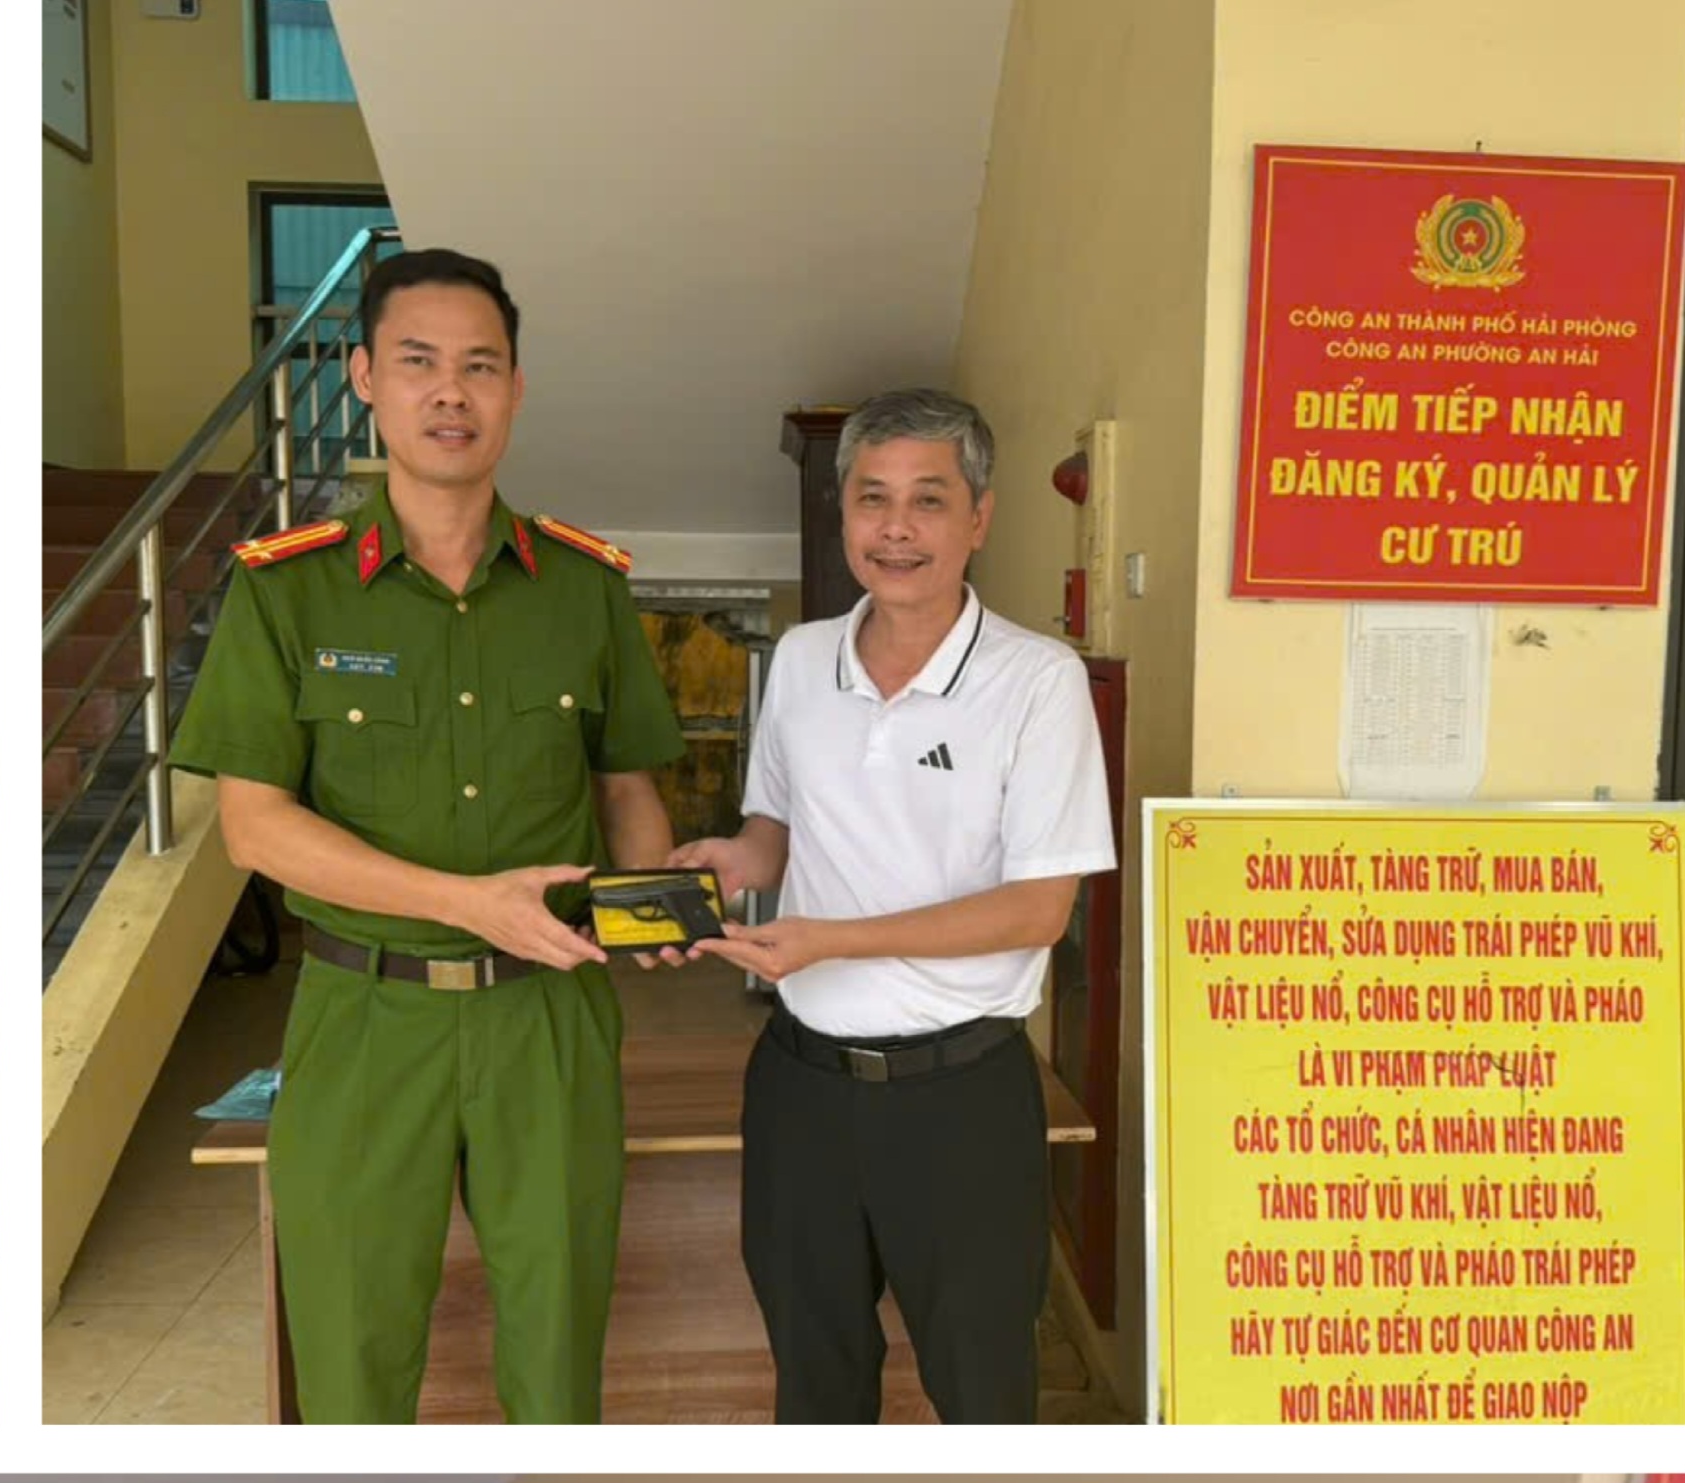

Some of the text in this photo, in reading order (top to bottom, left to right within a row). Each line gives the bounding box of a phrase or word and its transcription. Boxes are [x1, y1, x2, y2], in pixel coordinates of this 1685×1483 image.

[1289, 306, 1354, 328] CÔNG
[1361, 312, 1391, 329] AN
[1397, 311, 1466, 331] THÀNH
[1472, 311, 1516, 333] PHỐ
[1563, 317, 1637, 337] PHÒNG
[1326, 337, 1391, 359] CÔNG
[1397, 344, 1427, 360] AN
[1528, 348, 1557, 364] AN
[1294, 377, 1623, 444] ĐIỂM TIẾP NHẬN
[1270, 450, 1639, 505] ĐĂNG KÝ, QUẢN LÝ
[1380, 521, 1523, 566] CƯ TRÚ
[1246, 838, 1603, 895] SẢN XUẤT, TÀNG TRỮ, MUA BÁN,
[1186, 911, 1231, 963] VẬN
[1239, 905, 1334, 960] CHUYỂN,
[1394, 920, 1456, 964] DỤNG
[1462, 914, 1513, 957] TRÁI
[1520, 914, 1578, 957] PHÉP
[1585, 915, 1613, 957] VŨ
[1620, 915, 1663, 960] KHÍ,
[1208, 970, 1644, 1031] VẬT LIỆU NỔ, CÔNG CỤ HỖ TRỢ VÀ PHÁO
[1299, 1042, 1326, 1087] LÀ
[1332, 1050, 1353, 1087] VI
[1360, 1050, 1426, 1095] PHẠM
[1258, 1168, 1602, 1228] TÀNG TRỮ VŨ KHÍ, VẬT LIỆU NỔ,
[1226, 1235, 1636, 1296] CÔNG CỤ HỖ TRỢ VÀ PHÁO TRÁI PHÉP
[1231, 1303, 1634, 1363] HÃY TỰ GIÁC ĐẾN CƠ QUAN CÔNG AN
[1280, 1383, 1320, 1424] NƠI
[1327, 1372, 1375, 1424] GẦN
[1381, 1371, 1441, 1422] NHẤT
[1446, 1368, 1476, 1421] ĐỂ
[1482, 1381, 1535, 1421] GIAO
